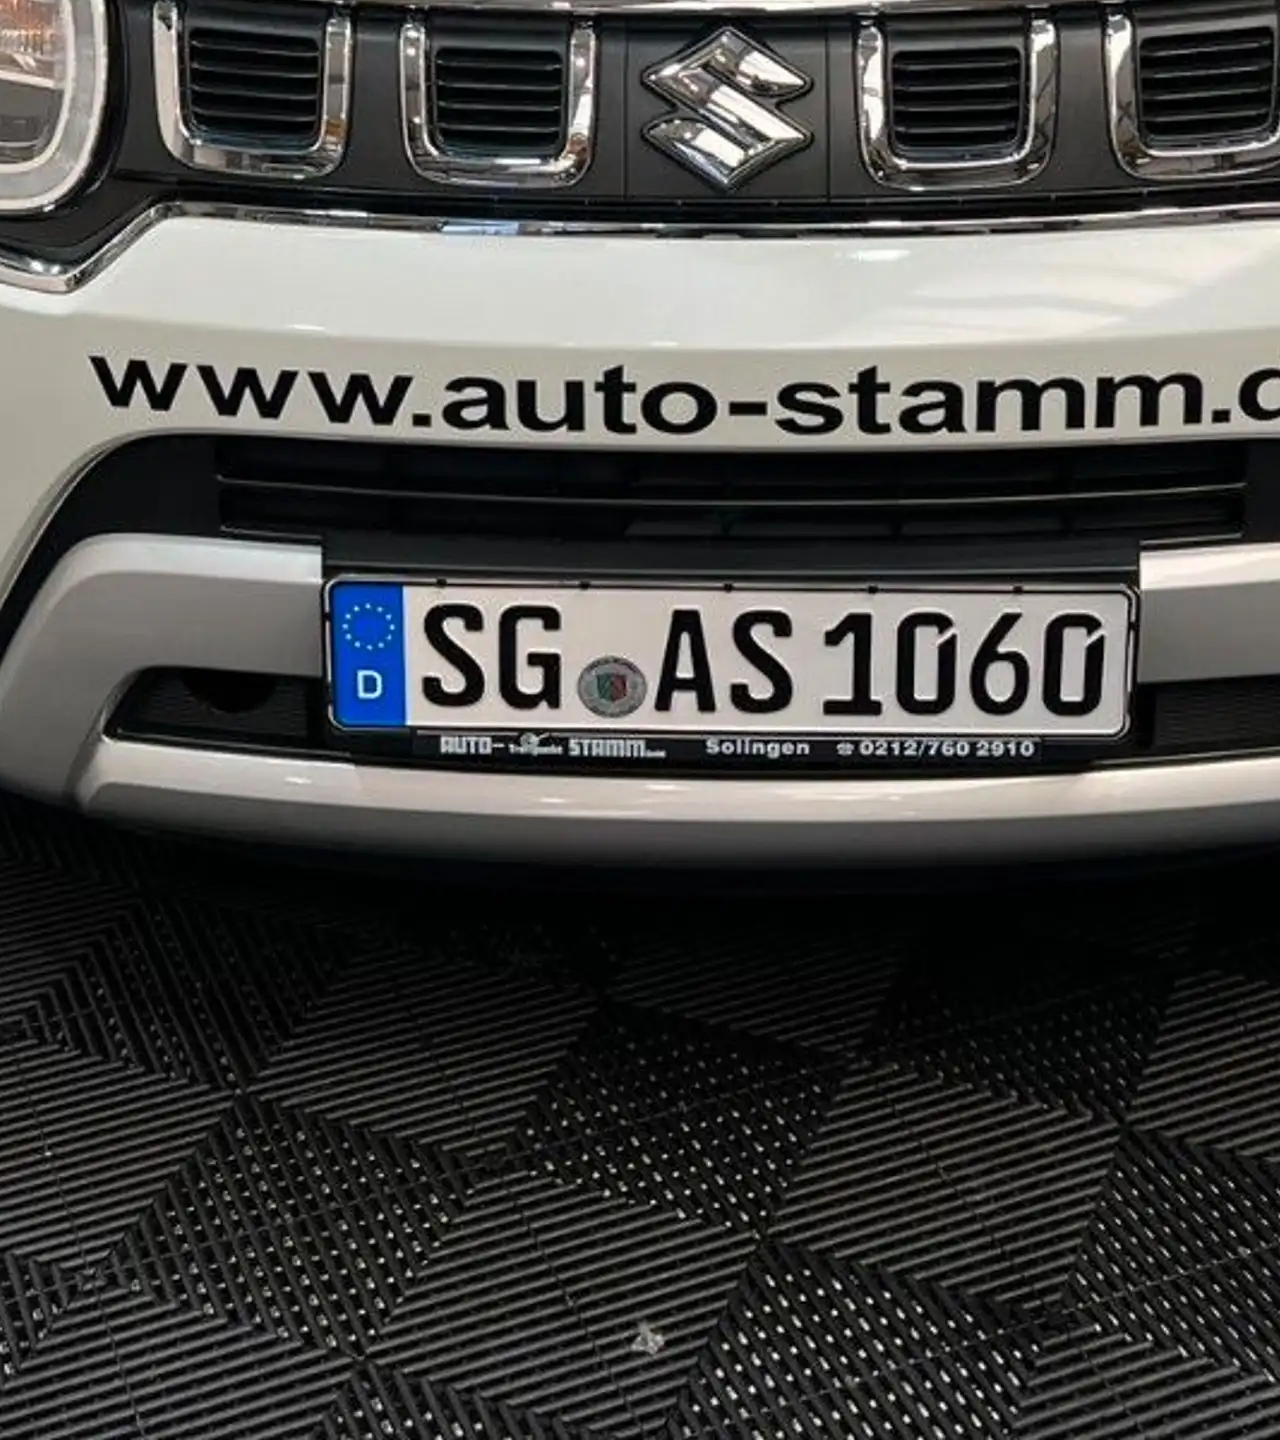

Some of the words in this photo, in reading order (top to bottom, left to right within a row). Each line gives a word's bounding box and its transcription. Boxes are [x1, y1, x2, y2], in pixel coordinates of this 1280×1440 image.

[421, 603, 562, 710] SG
[357, 669, 383, 699] D
[568, 737, 646, 758] STAMM
[704, 737, 810, 759] Solingen
[859, 739, 970, 758] 0212/760
[975, 740, 1035, 758] 2910
